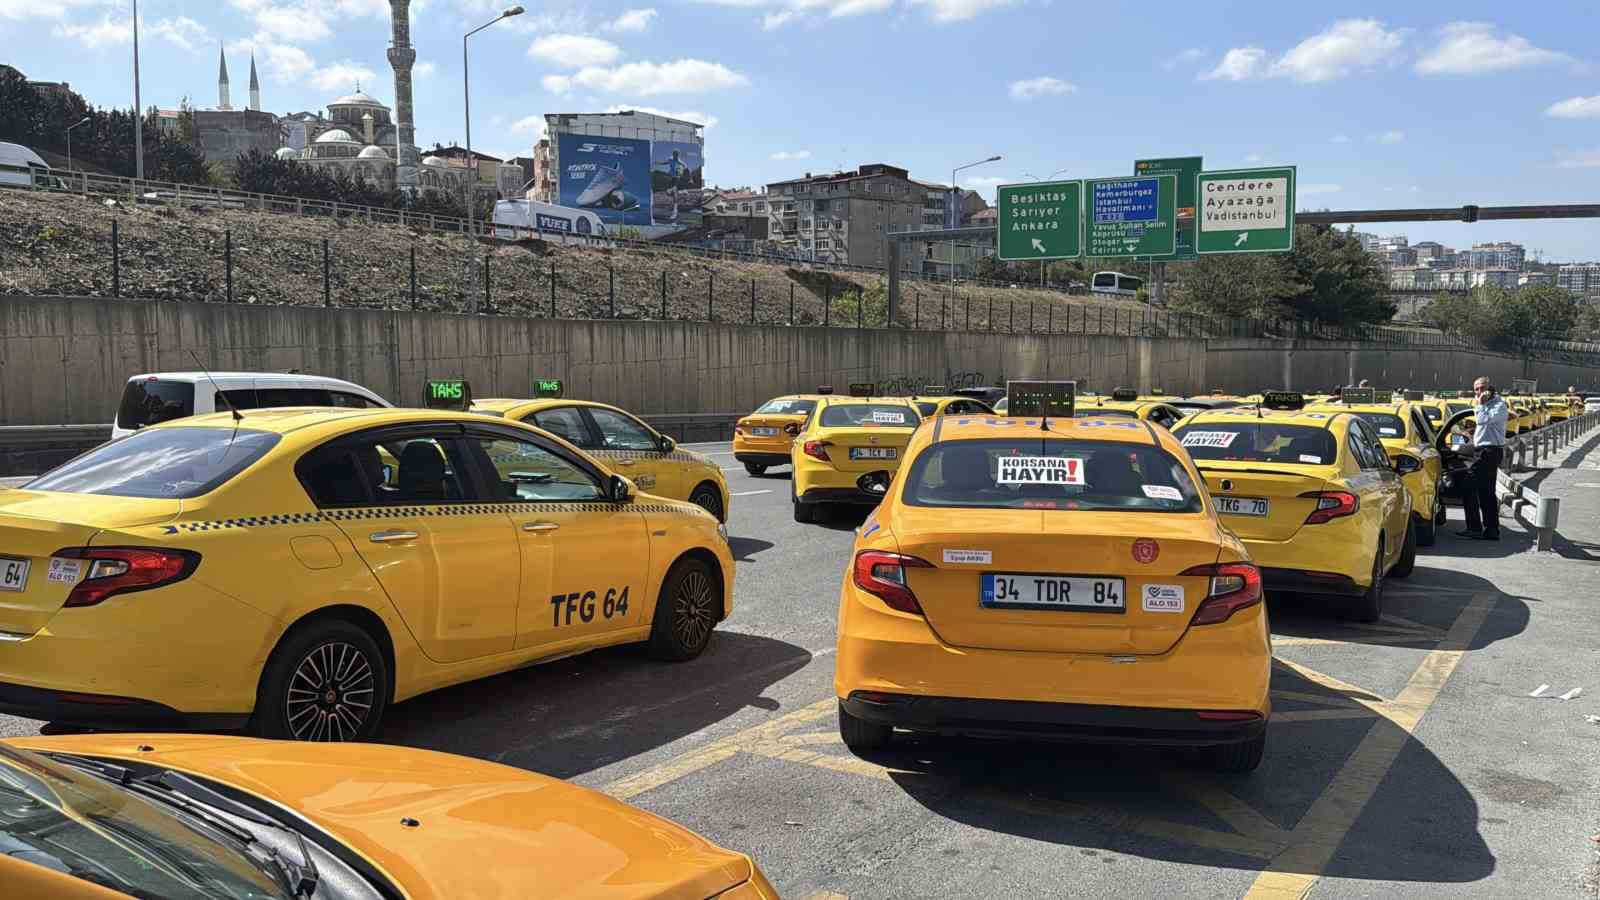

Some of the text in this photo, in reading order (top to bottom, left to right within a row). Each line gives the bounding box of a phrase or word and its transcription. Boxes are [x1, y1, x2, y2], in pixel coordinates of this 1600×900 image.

[1207, 181, 1273, 192] Cendere
[1206, 195, 1274, 209] Ayazağa
[1206, 208, 1276, 220] Vadistanbul
[1012, 221, 1059, 231] Ankara
[1003, 459, 1066, 468] KORSANA
[1220, 498, 1266, 513] TKG 70
[5, 562, 21, 585] 64
[996, 579, 1020, 601] 34
[1034, 579, 1071, 602] TDR
[1094, 582, 1119, 604] 84
[551, 585, 630, 627] TFG 64
